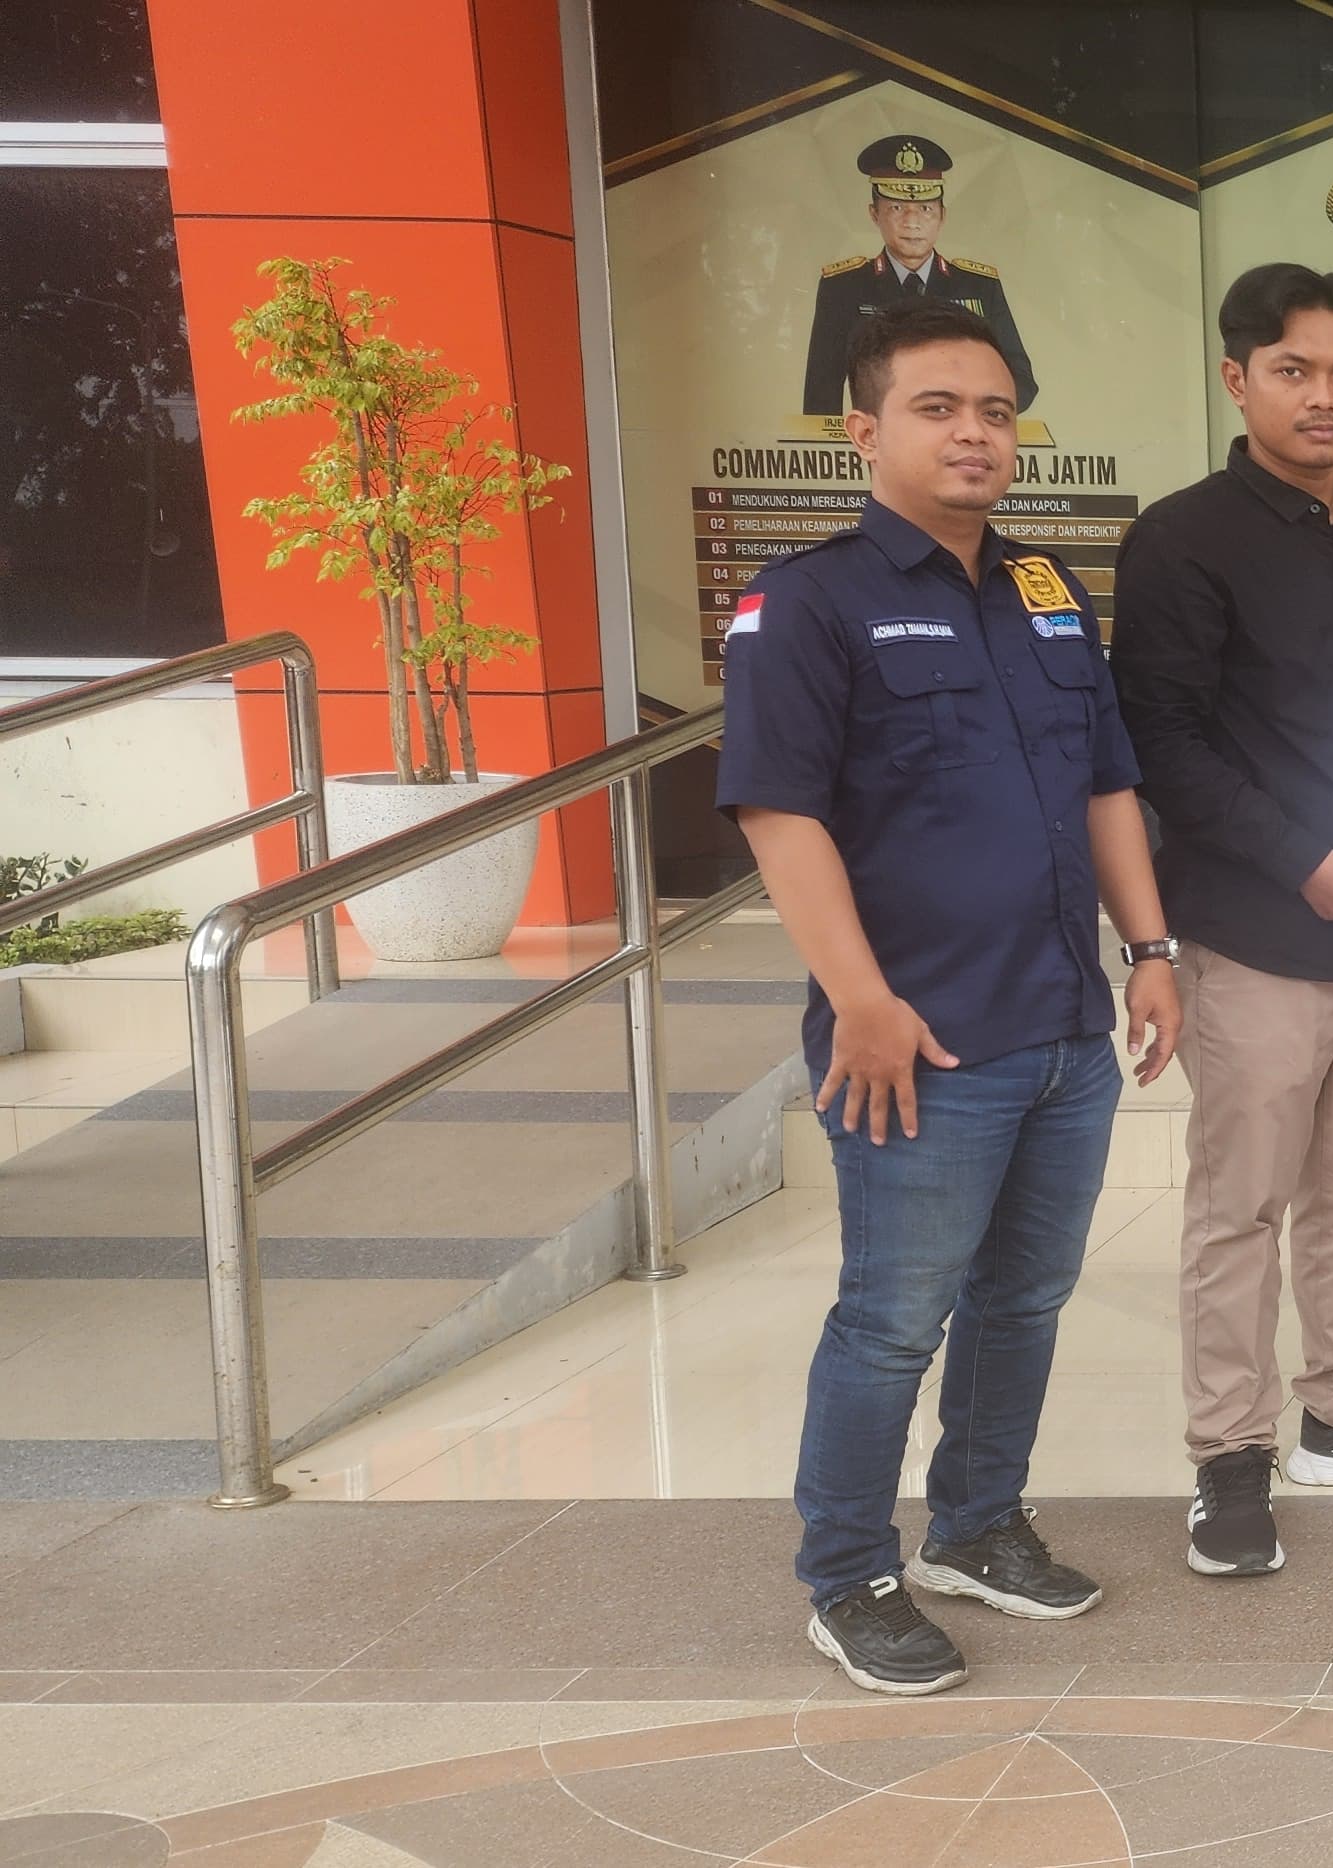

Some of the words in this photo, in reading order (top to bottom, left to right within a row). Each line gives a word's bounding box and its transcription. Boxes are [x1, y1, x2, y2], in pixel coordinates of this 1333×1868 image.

[713, 448, 864, 481] COMMANDER
[1048, 455, 1117, 485] JATIM
[709, 492, 722, 503] 01
[732, 494, 789, 507] MENDUKUNG
[791, 495, 810, 508] DAN
[1012, 500, 1030, 512] DAN
[1032, 500, 1071, 512] KAPOLRI
[710, 518, 725, 529] 02
[734, 519, 800, 532] PEMELIHARAAN
[1009, 524, 1056, 537] RESPONSIF
[1058, 525, 1076, 536] DAN
[1078, 525, 1121, 538] PREDIKTIF
[712, 543, 727, 554] 03
[735, 543, 792, 556] PENEGAKAN
[713, 568, 728, 580] 04
[715, 593, 730, 605] 05
[716, 618, 731, 631] 06
